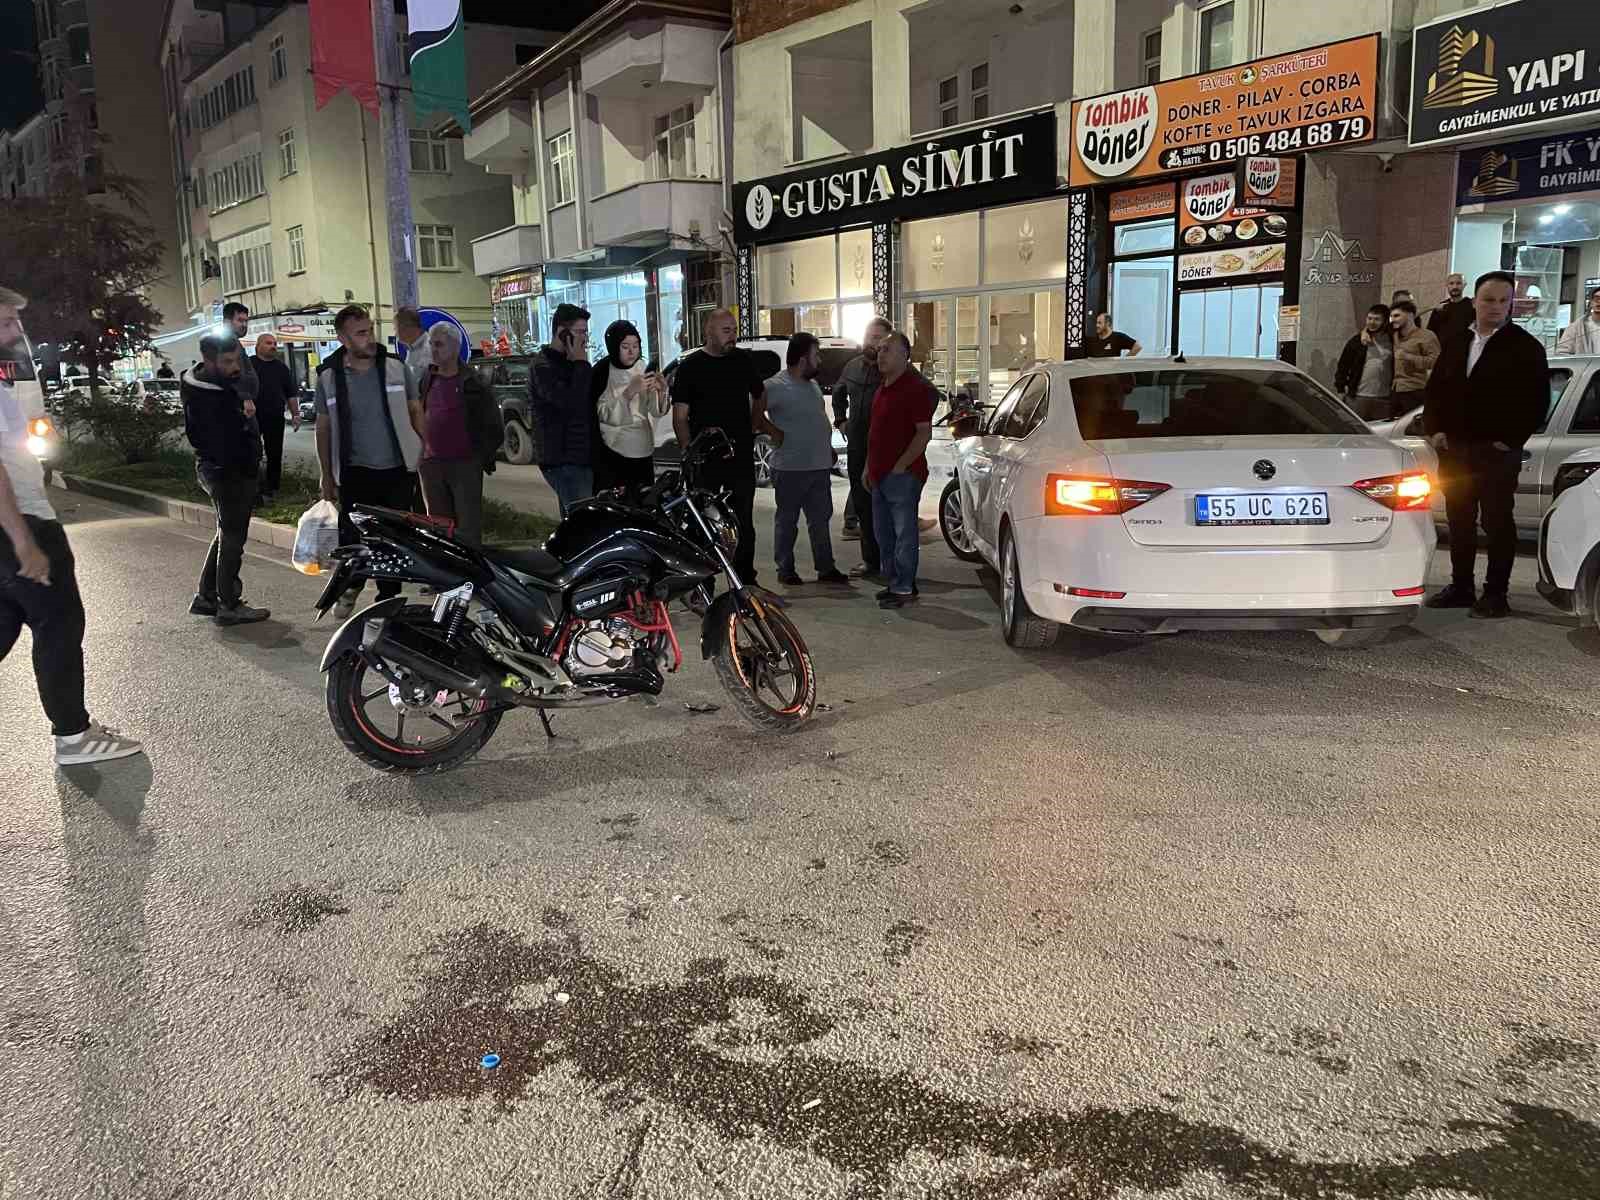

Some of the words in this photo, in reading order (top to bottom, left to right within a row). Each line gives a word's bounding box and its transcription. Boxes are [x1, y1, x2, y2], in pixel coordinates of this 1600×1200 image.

[1507, 49, 1585, 95] YAPI
[1217, 123, 1232, 135] ve
[1237, 107, 1291, 132] TAVUK
[1438, 104, 1537, 133] GAYRİMENKUL
[1540, 97, 1559, 113] VE
[1209, 142, 1220, 160] 0
[1225, 135, 1260, 159] 506
[1265, 127, 1302, 151] 484
[1307, 122, 1332, 145] 68
[1338, 117, 1364, 140] 79
[1540, 141, 1573, 169] FK
[782, 164, 895, 219] GUSTA
[901, 129, 1024, 197] SİMİT
[1211, 498, 1236, 517] 55
[1248, 497, 1273, 516] UC
[1285, 497, 1322, 516] 626
